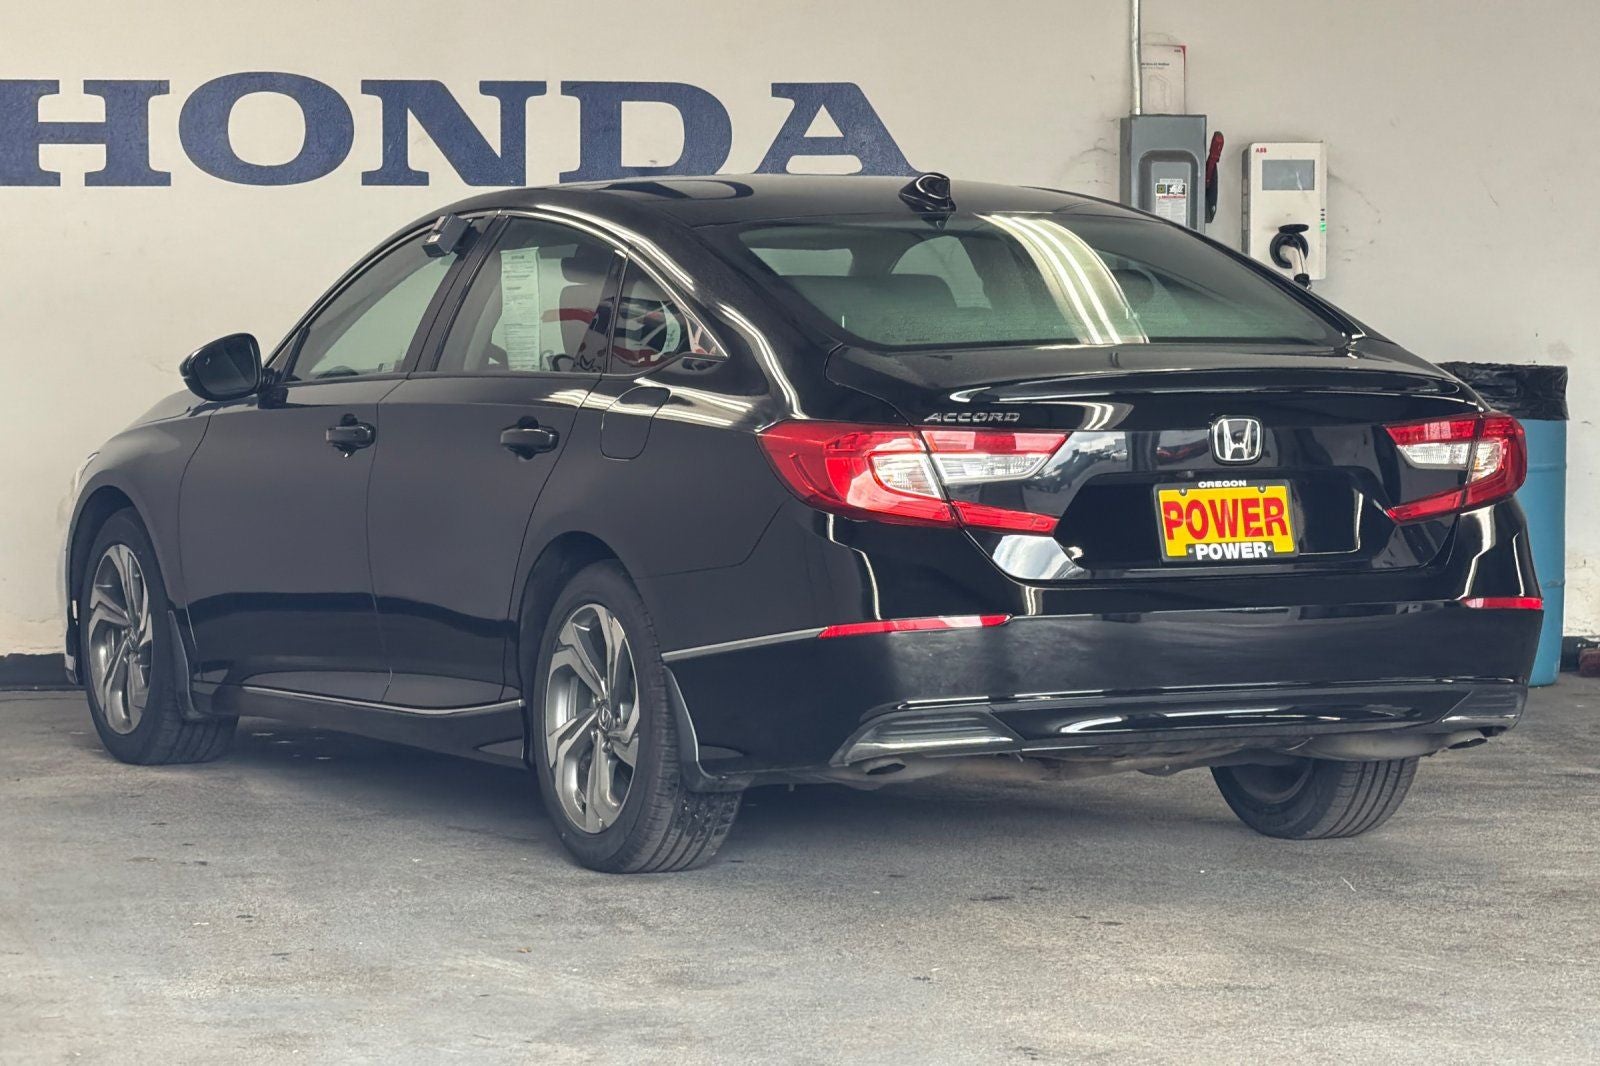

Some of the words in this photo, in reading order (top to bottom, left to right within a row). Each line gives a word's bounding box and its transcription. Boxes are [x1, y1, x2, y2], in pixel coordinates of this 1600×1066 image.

[0, 71, 921, 187] HONDA
[923, 412, 1020, 422] ACCORD
[1198, 480, 1247, 488] OREGON
[1162, 497, 1288, 540] POWER
[1195, 541, 1268, 560] POWER
